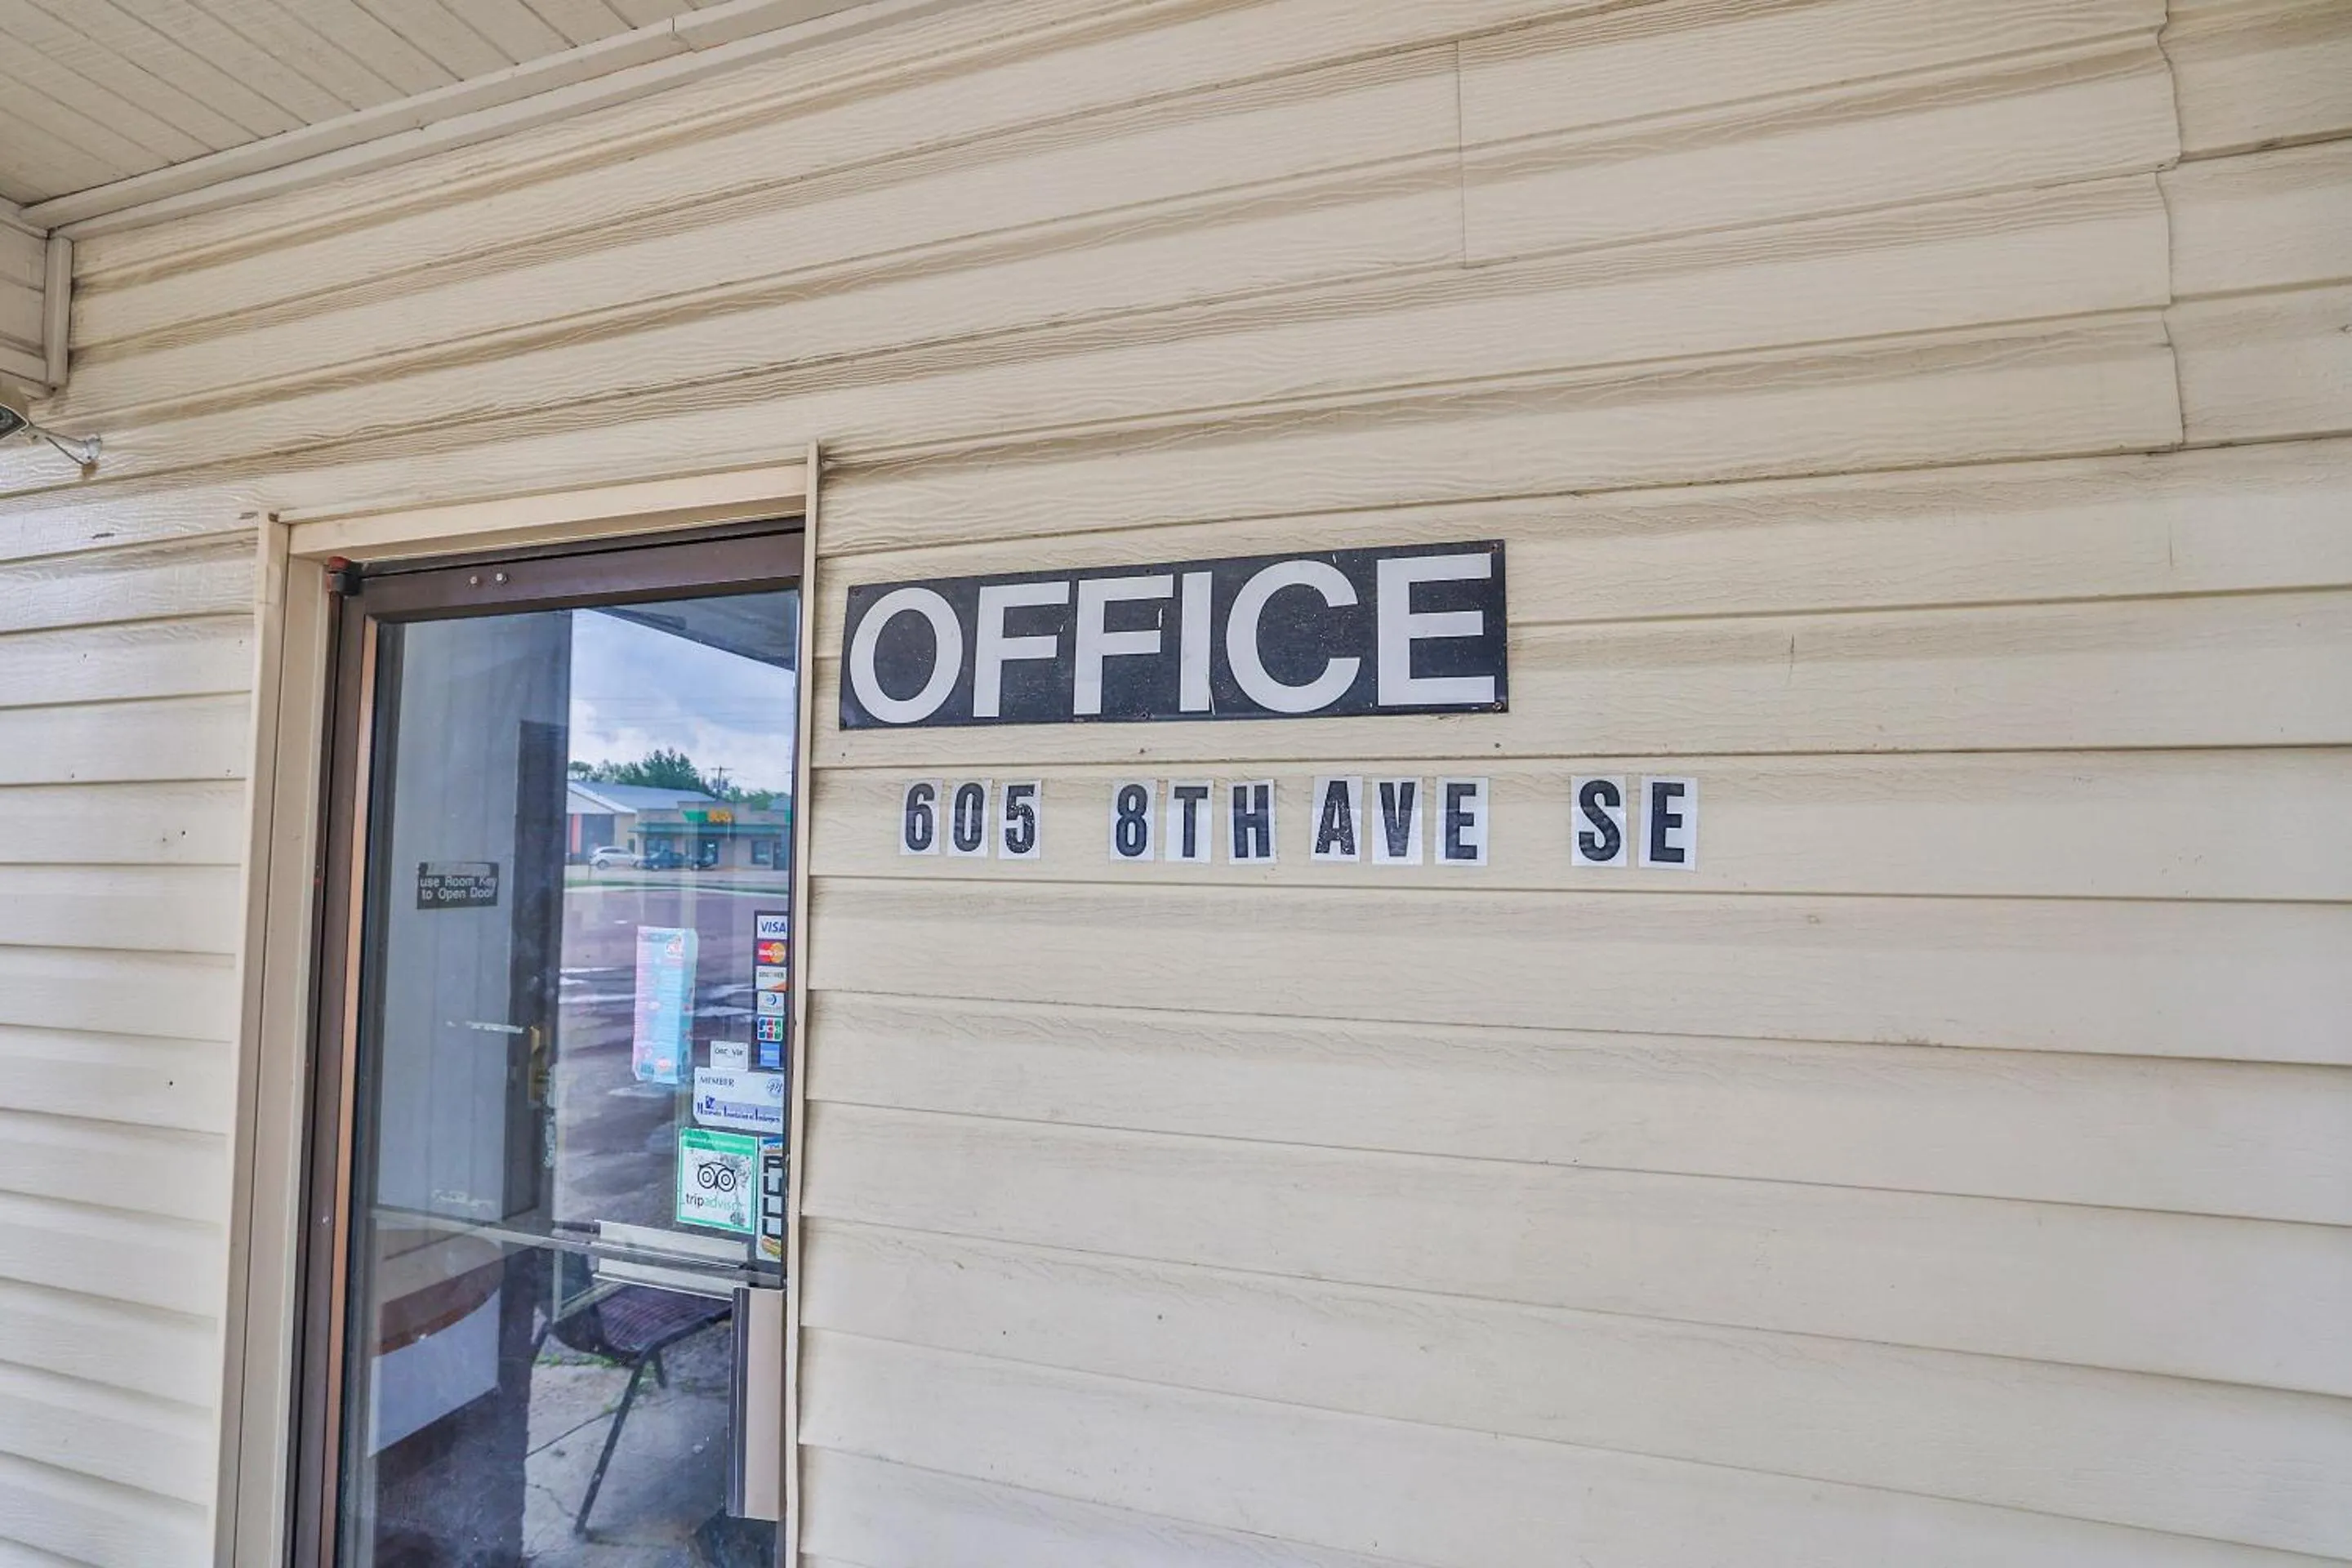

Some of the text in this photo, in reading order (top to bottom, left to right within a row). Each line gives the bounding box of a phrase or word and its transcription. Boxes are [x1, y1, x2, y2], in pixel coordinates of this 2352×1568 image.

[849, 553, 1496, 724] OFFICE
[905, 780, 1685, 863] 605 8TH AVE SE
[445, 875, 474, 887] Room
[421, 888, 434, 901] to
[438, 888, 466, 902] Open
[760, 921, 786, 933] VISA
